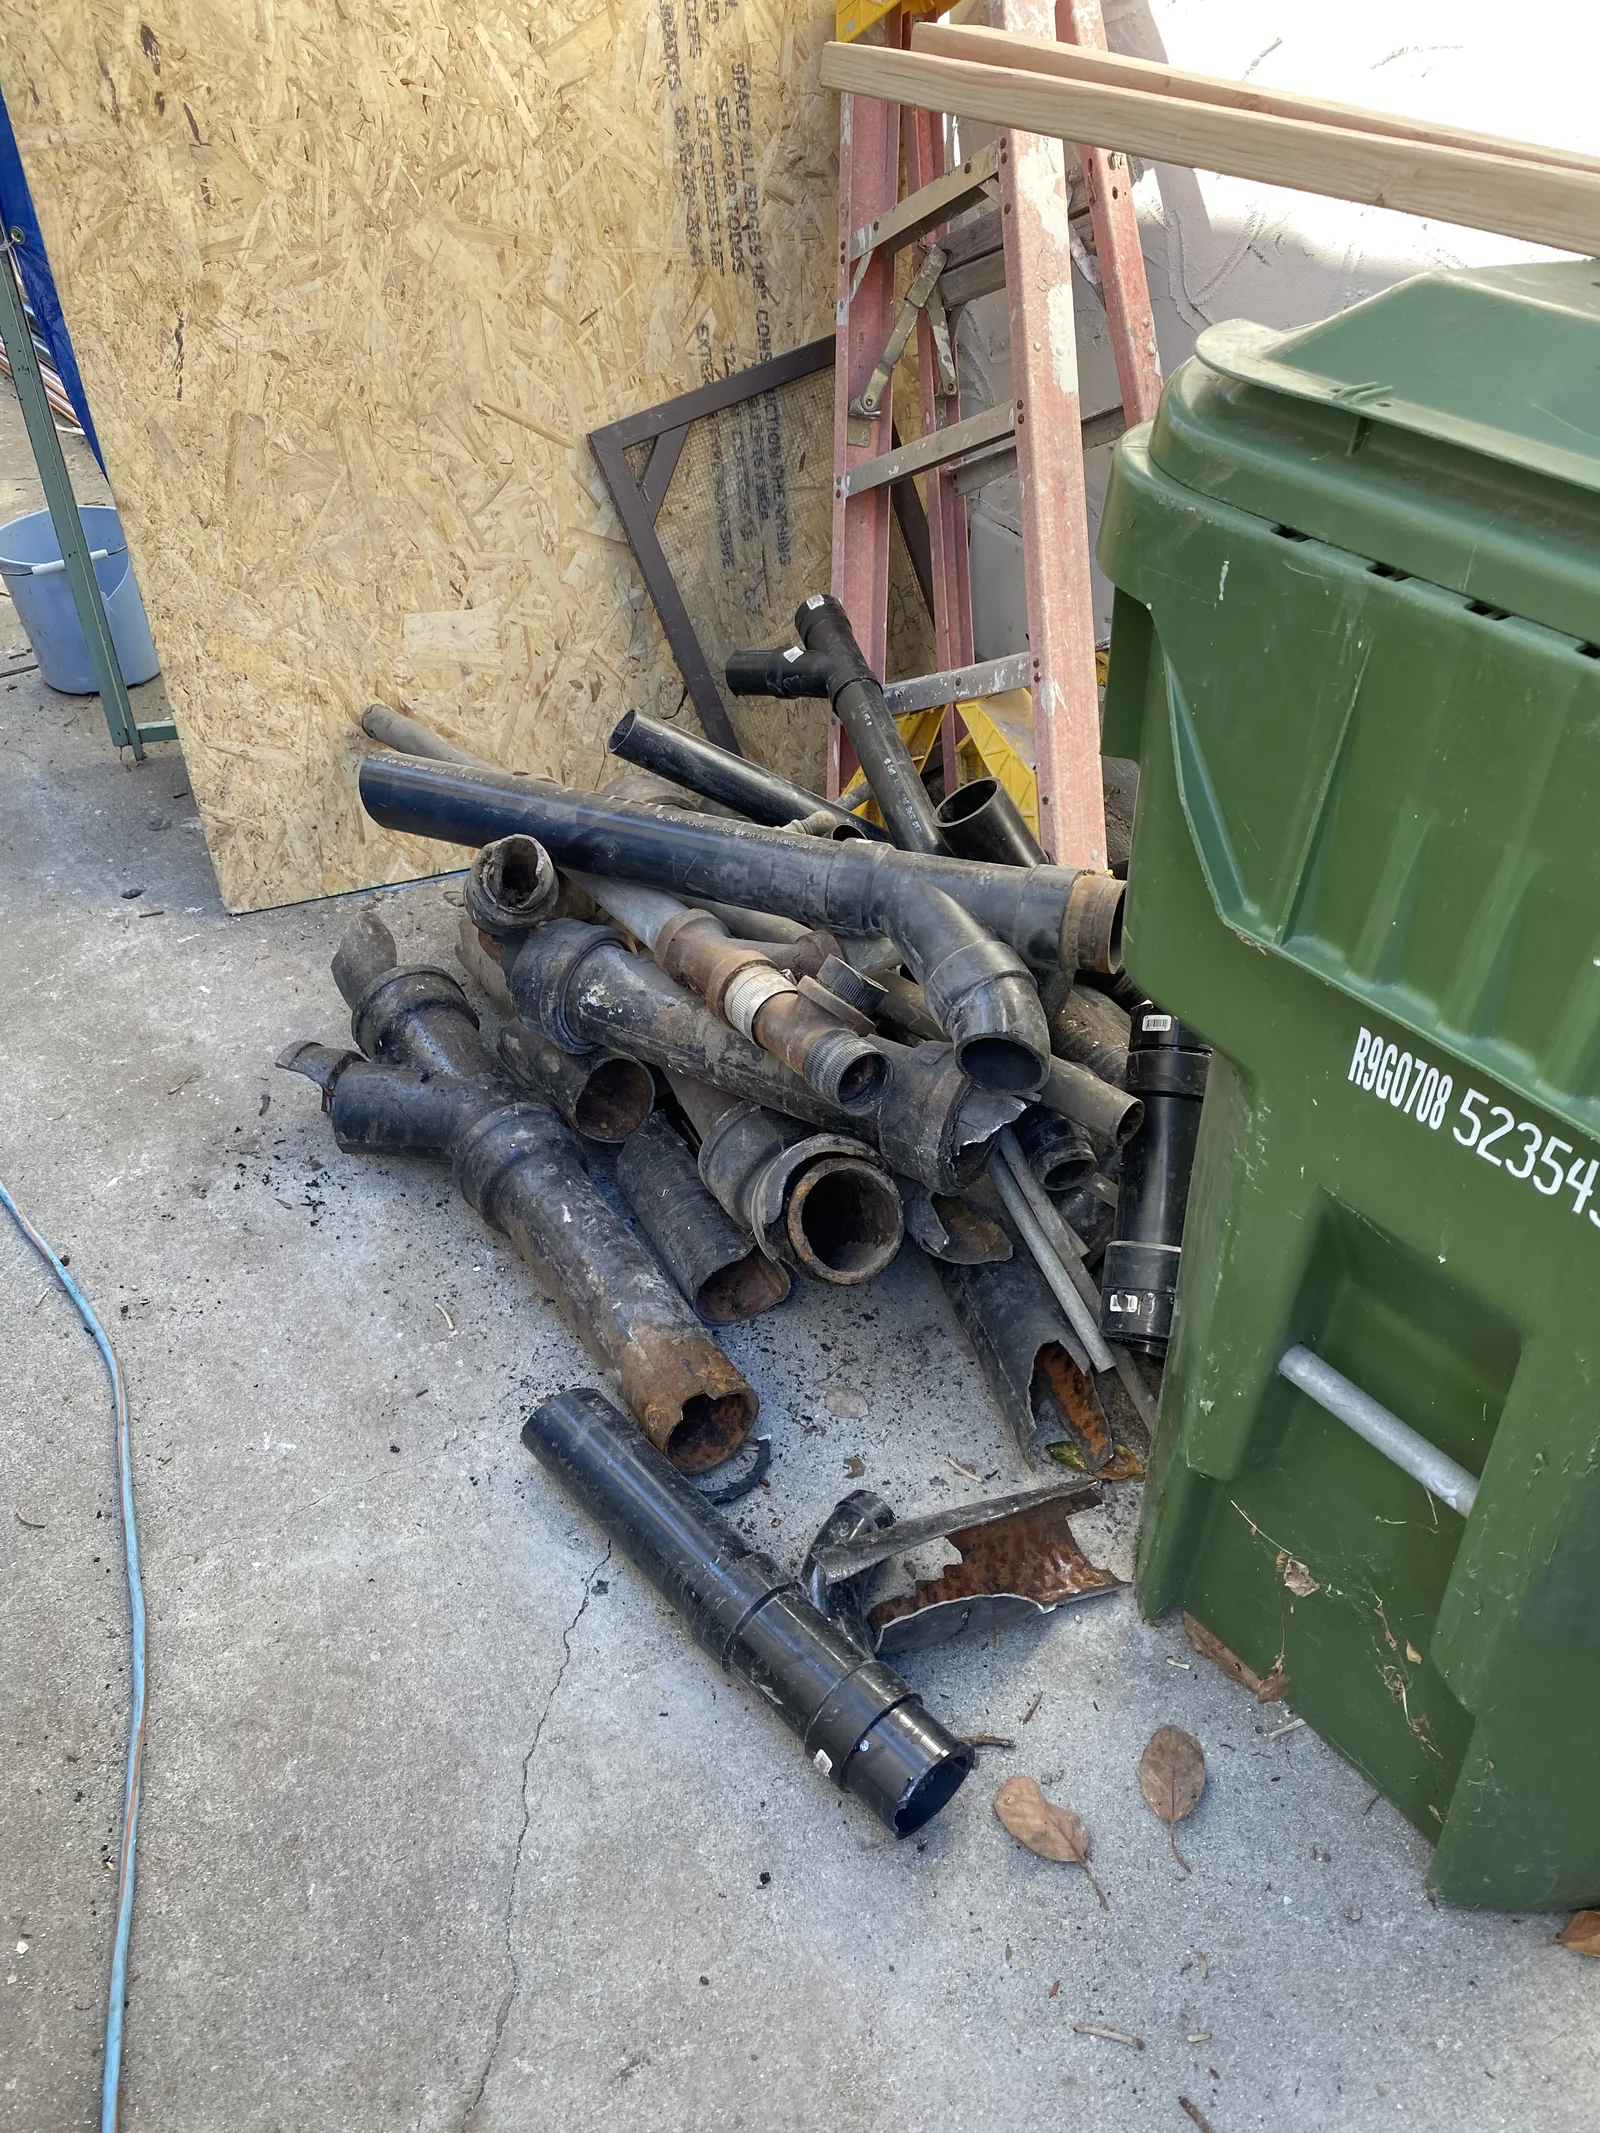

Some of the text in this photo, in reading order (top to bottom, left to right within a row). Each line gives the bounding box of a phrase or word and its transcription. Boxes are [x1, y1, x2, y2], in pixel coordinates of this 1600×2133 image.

[732, 62, 751, 131] SPACE
[744, 186, 762, 256] EDGES
[1347, 1026, 1453, 1130] R9G0708
